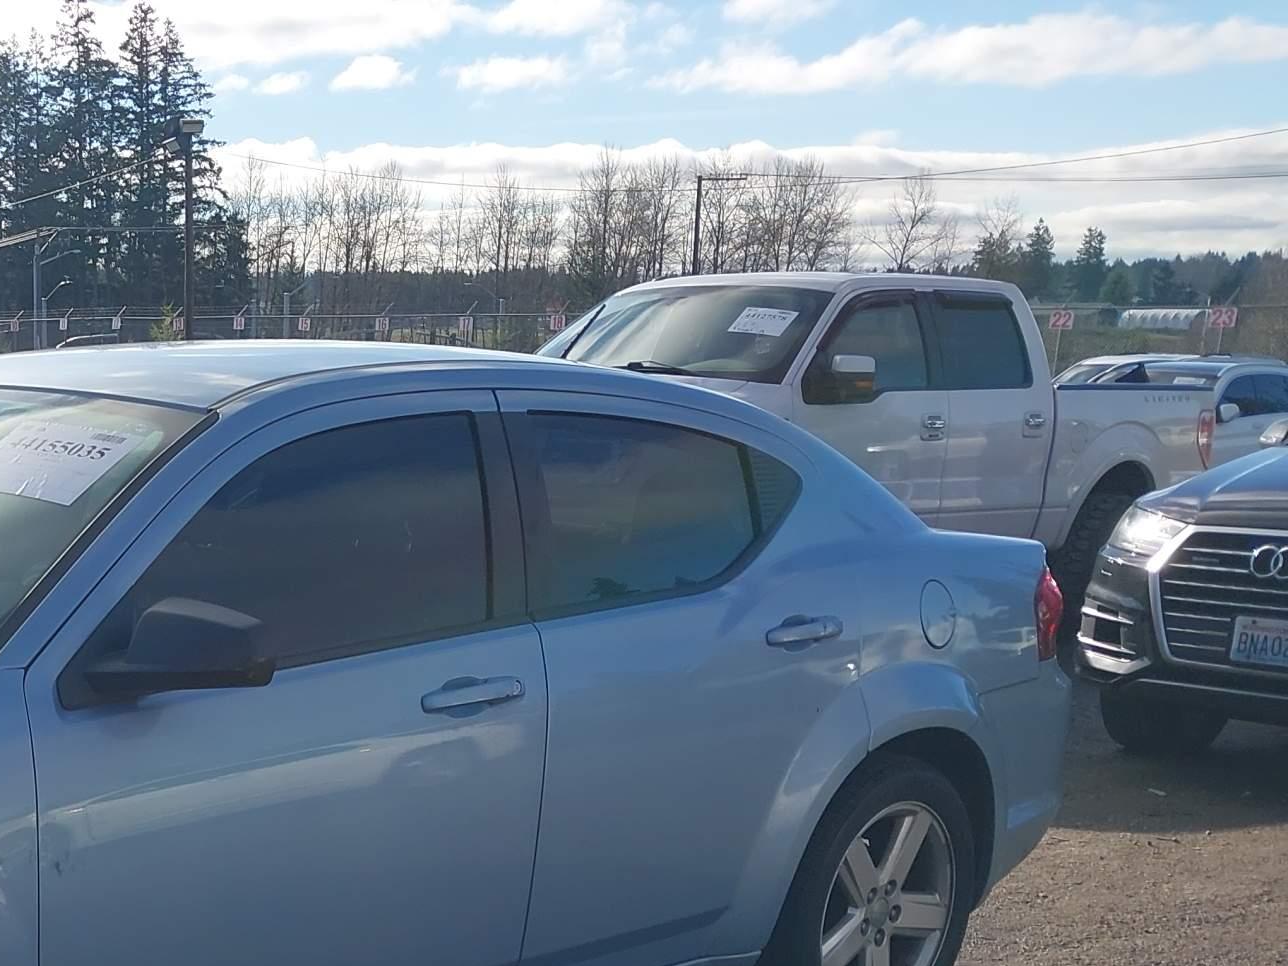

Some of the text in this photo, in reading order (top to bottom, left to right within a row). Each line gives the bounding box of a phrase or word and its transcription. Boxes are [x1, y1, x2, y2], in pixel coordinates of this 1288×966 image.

[300, 318, 309, 329] 15
[1051, 311, 1072, 328] 22
[1211, 309, 1235, 326] 23
[11, 436, 112, 460] 44155035
